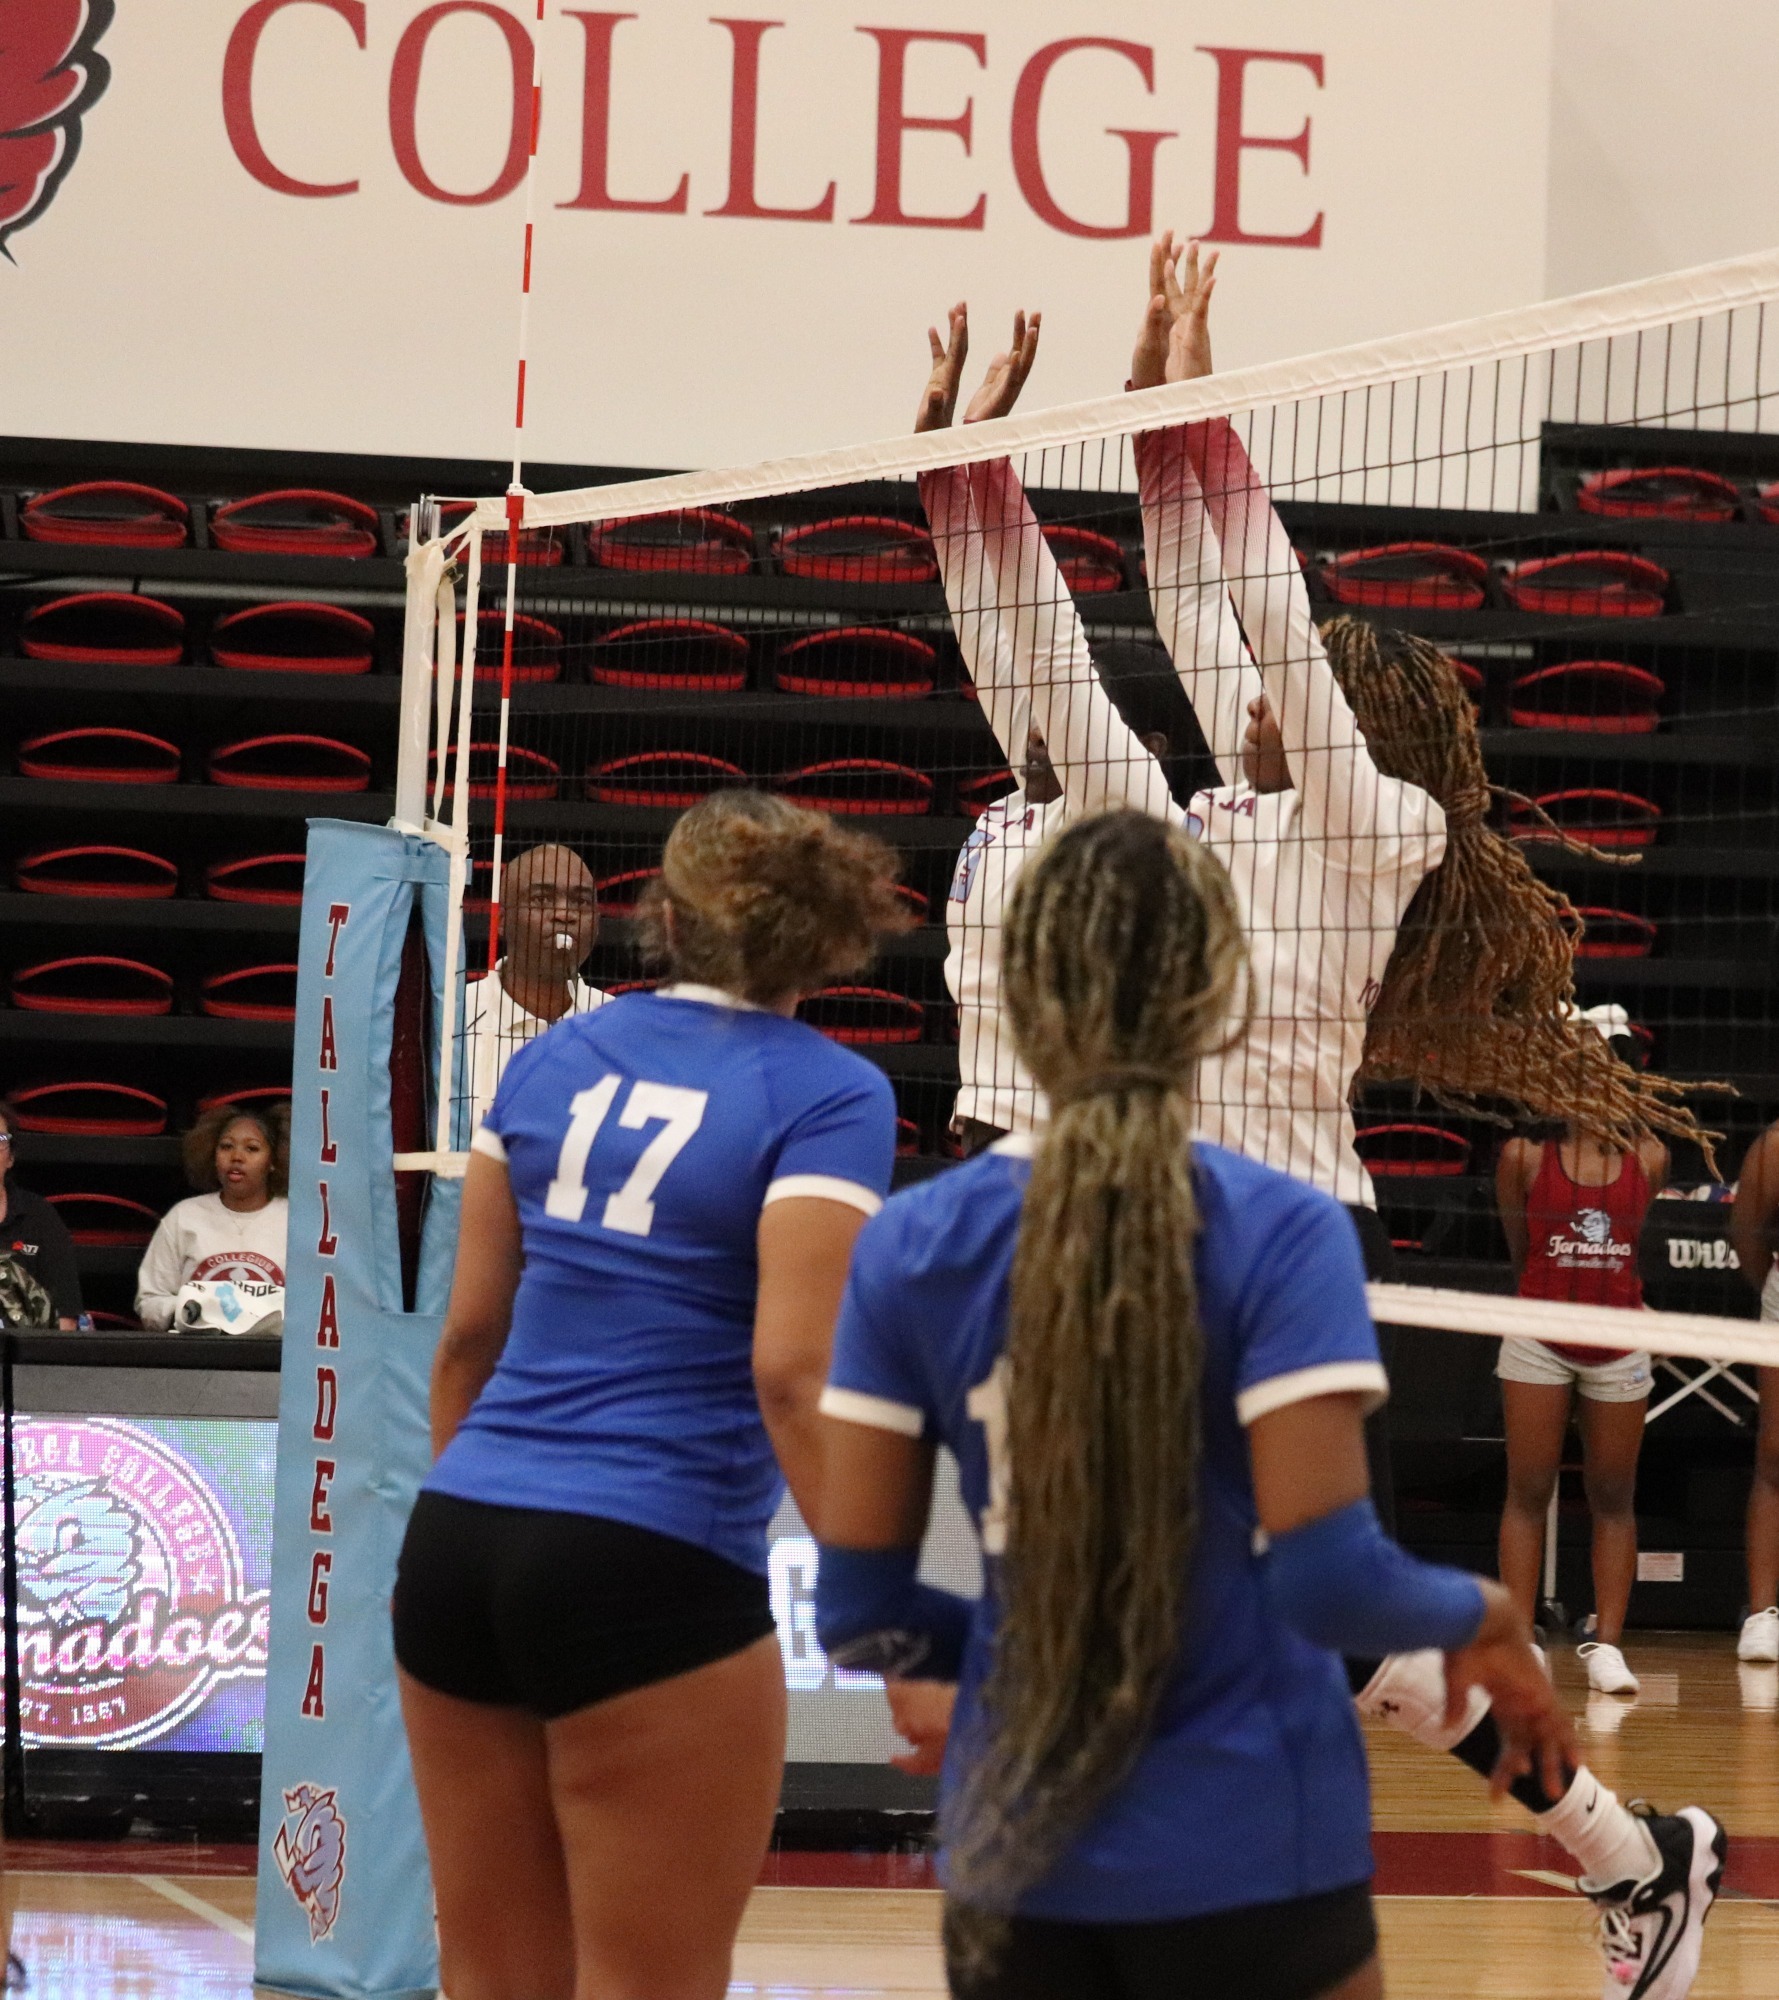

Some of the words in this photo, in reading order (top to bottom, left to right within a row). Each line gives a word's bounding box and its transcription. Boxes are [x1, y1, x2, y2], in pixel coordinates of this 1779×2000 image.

[222, 0, 1326, 249] COLLEGE
[544, 1073, 709, 1238] 17
[207, 1252, 275, 1272] COLLEGIUM
[300, 902, 352, 1720] TALLADEGA
[1666, 1239, 1741, 1270] Wils
[16, 1593, 269, 1677] nadoes
